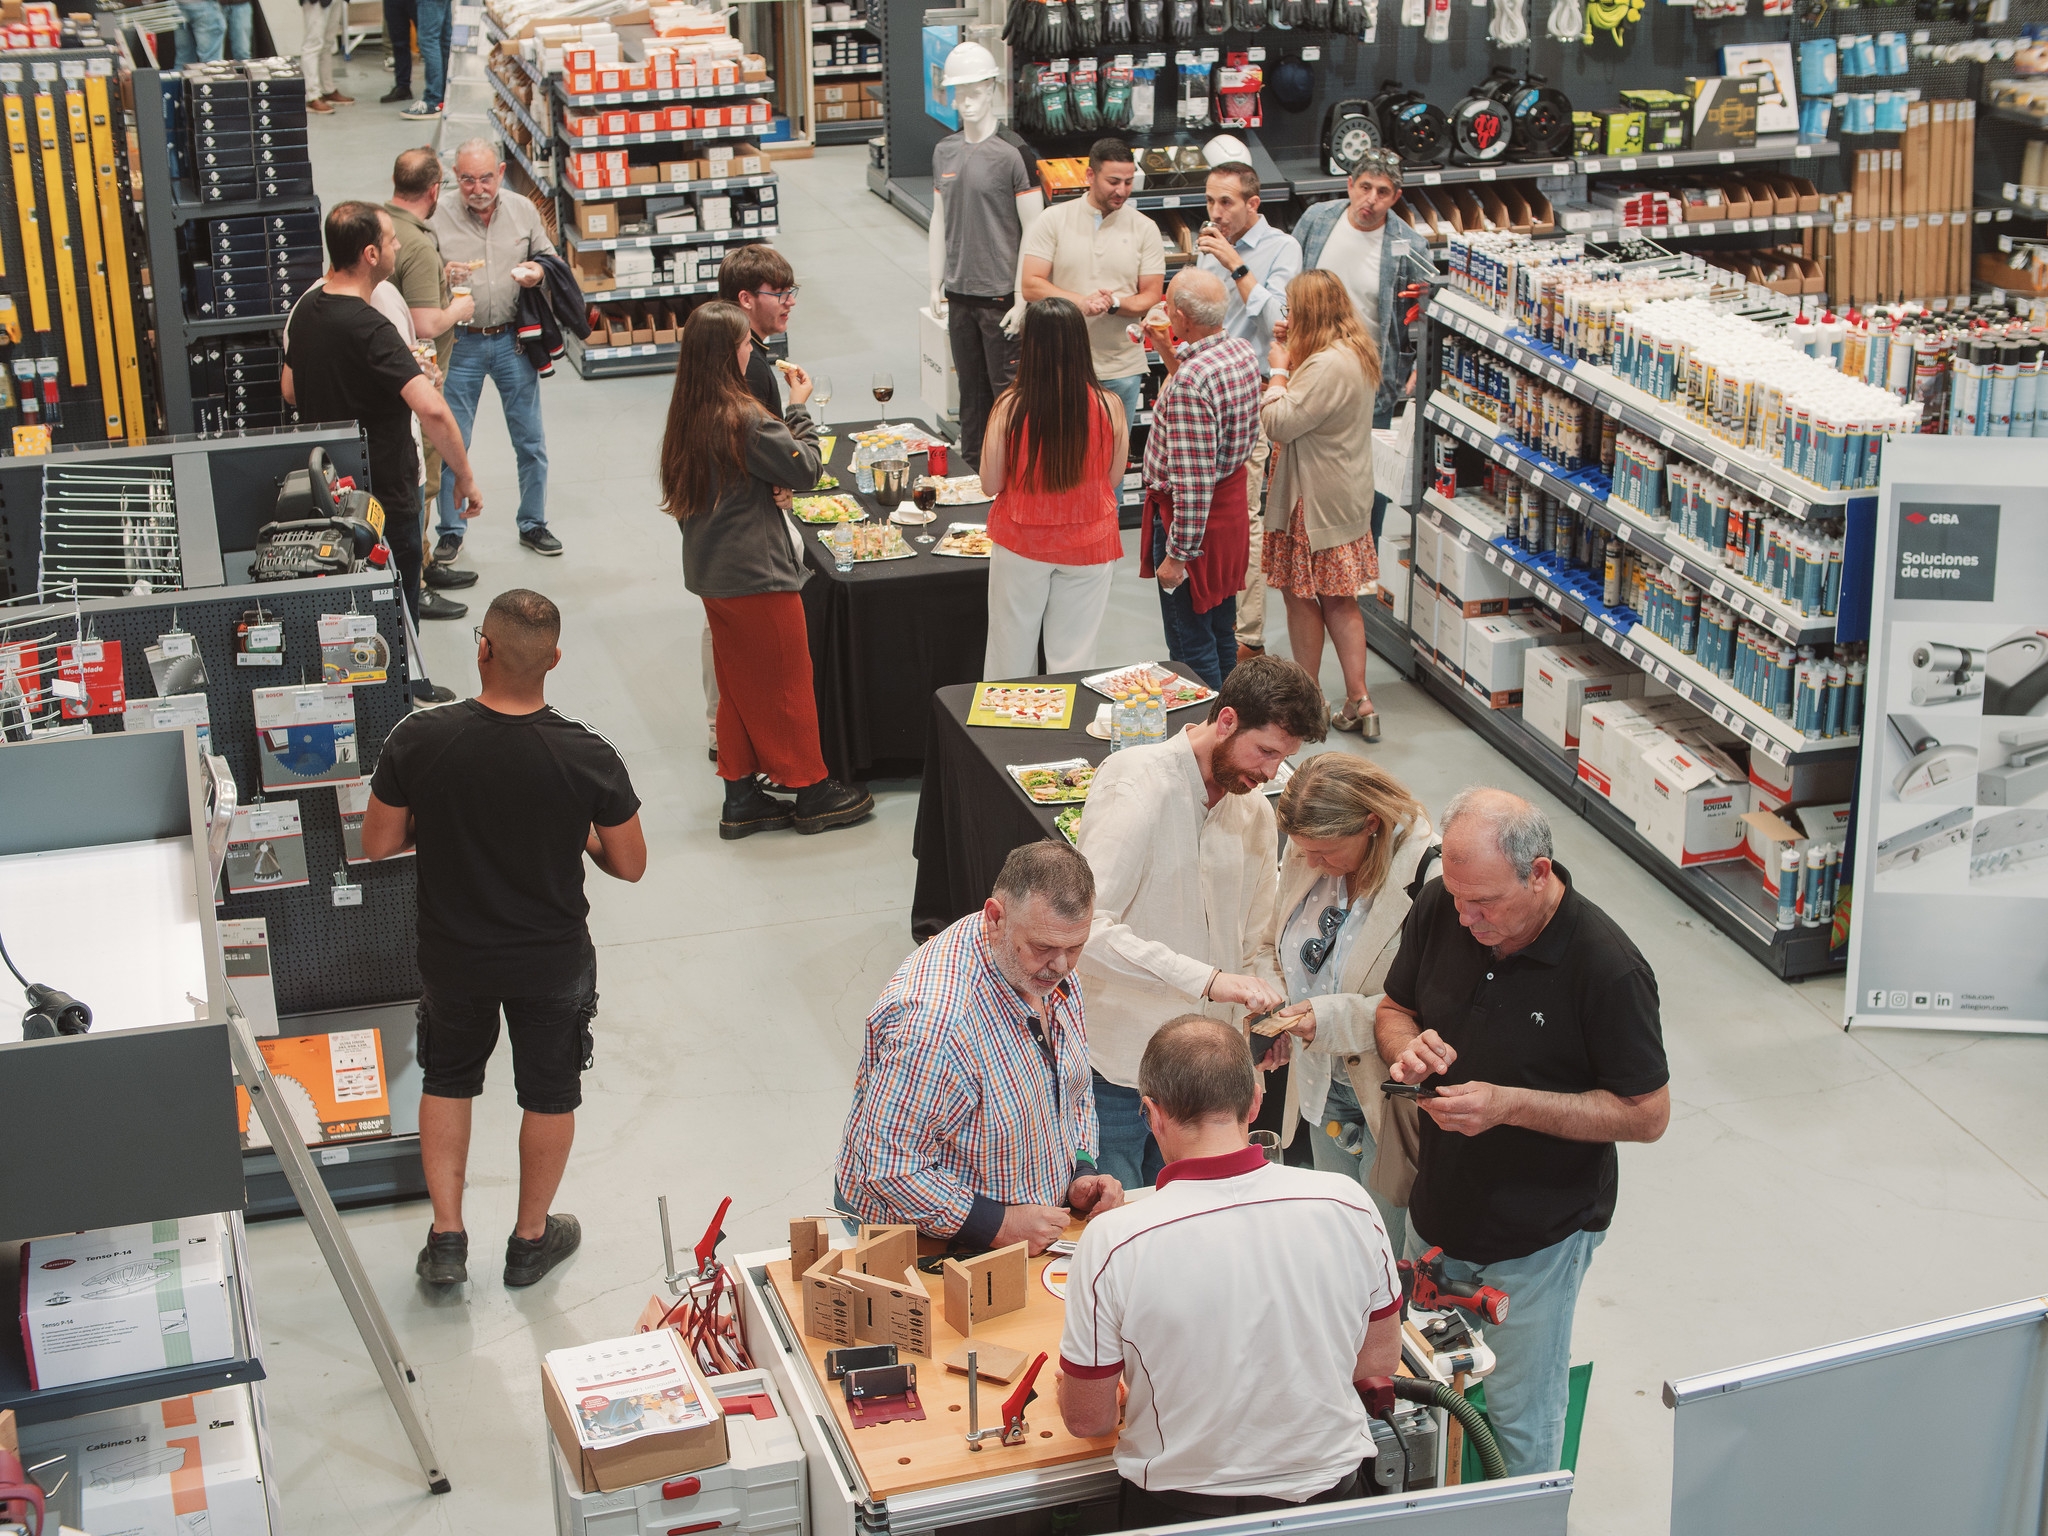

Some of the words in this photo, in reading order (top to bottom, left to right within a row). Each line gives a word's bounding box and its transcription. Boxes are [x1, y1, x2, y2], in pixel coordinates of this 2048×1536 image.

[1869, 440, 1880, 454] AS
[1865, 455, 1878, 486] Silirub
[1929, 513, 1960, 525] CISA
[1902, 552, 1979, 567] Soluciones
[1764, 560, 1775, 589] Silirub
[1901, 565, 1919, 578] de
[1921, 566, 1961, 579] cierre
[1584, 690, 1612, 699] SOUDAL
[1703, 802, 1732, 812] SOUDAL
[326, 1122, 357, 1134] CMT
[86, 1253, 112, 1262] Tenso
[114, 1249, 132, 1257] P-14
[41, 1321, 60, 1329] Tenso
[86, 1437, 132, 1452] Cabineo
[135, 1435, 147, 1443] 12
